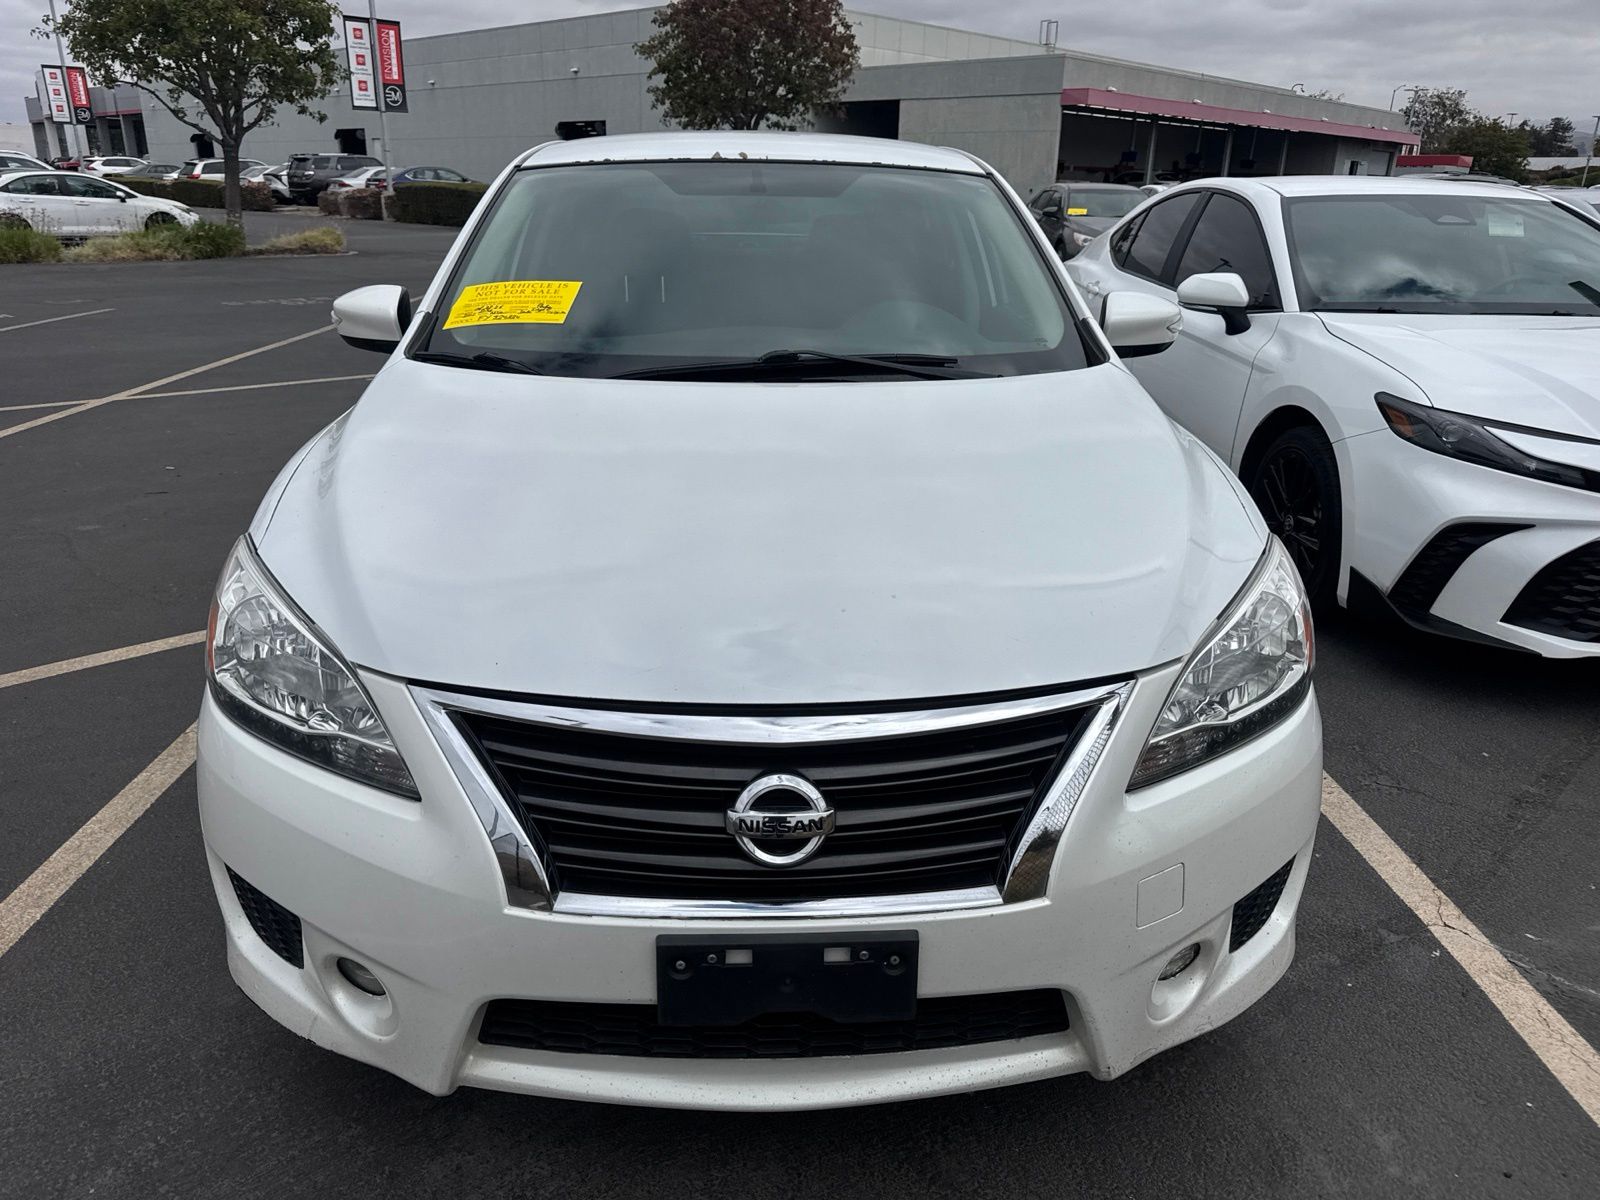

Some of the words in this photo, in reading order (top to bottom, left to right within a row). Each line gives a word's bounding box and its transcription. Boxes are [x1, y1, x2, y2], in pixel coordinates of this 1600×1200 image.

[381, 29, 393, 80] ENVISION
[474, 284, 500, 293] THIS
[503, 282, 555, 290] VEHICLE
[475, 289, 498, 298] NOT
[738, 818, 823, 834] NISSAN
